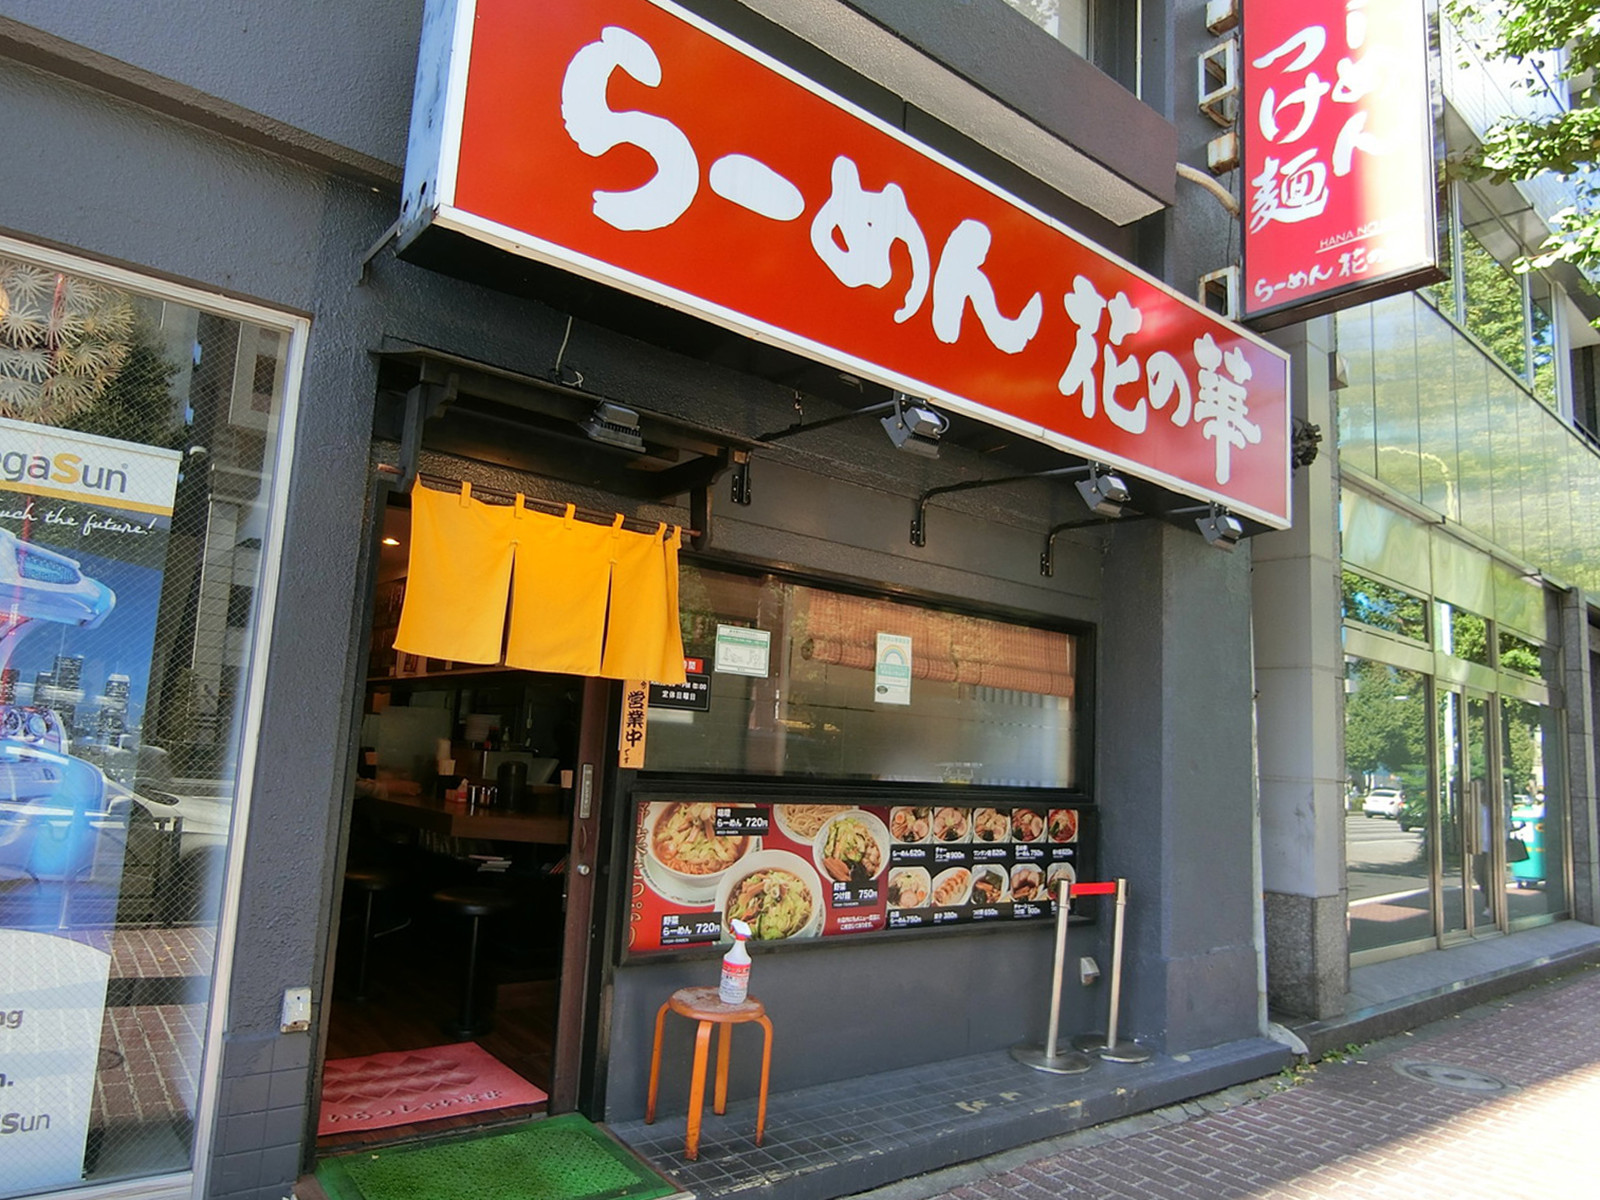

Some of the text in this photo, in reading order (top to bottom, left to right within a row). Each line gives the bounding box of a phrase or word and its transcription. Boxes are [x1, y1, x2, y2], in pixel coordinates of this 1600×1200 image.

[1252, 25, 1330, 235] つけ麺
[560, 26, 1261, 485] らーめん 花の華
[1319, 229, 1354, 249] HANA
[1254, 264, 1333, 302] らーめん
[0, 451, 127, 493] gaSun
[0, 502, 157, 536] uch the future!
[717, 817, 769, 828] らーめん 720円
[662, 922, 721, 936] らーめん 720円
[0, 1112, 50, 1134] Sun
